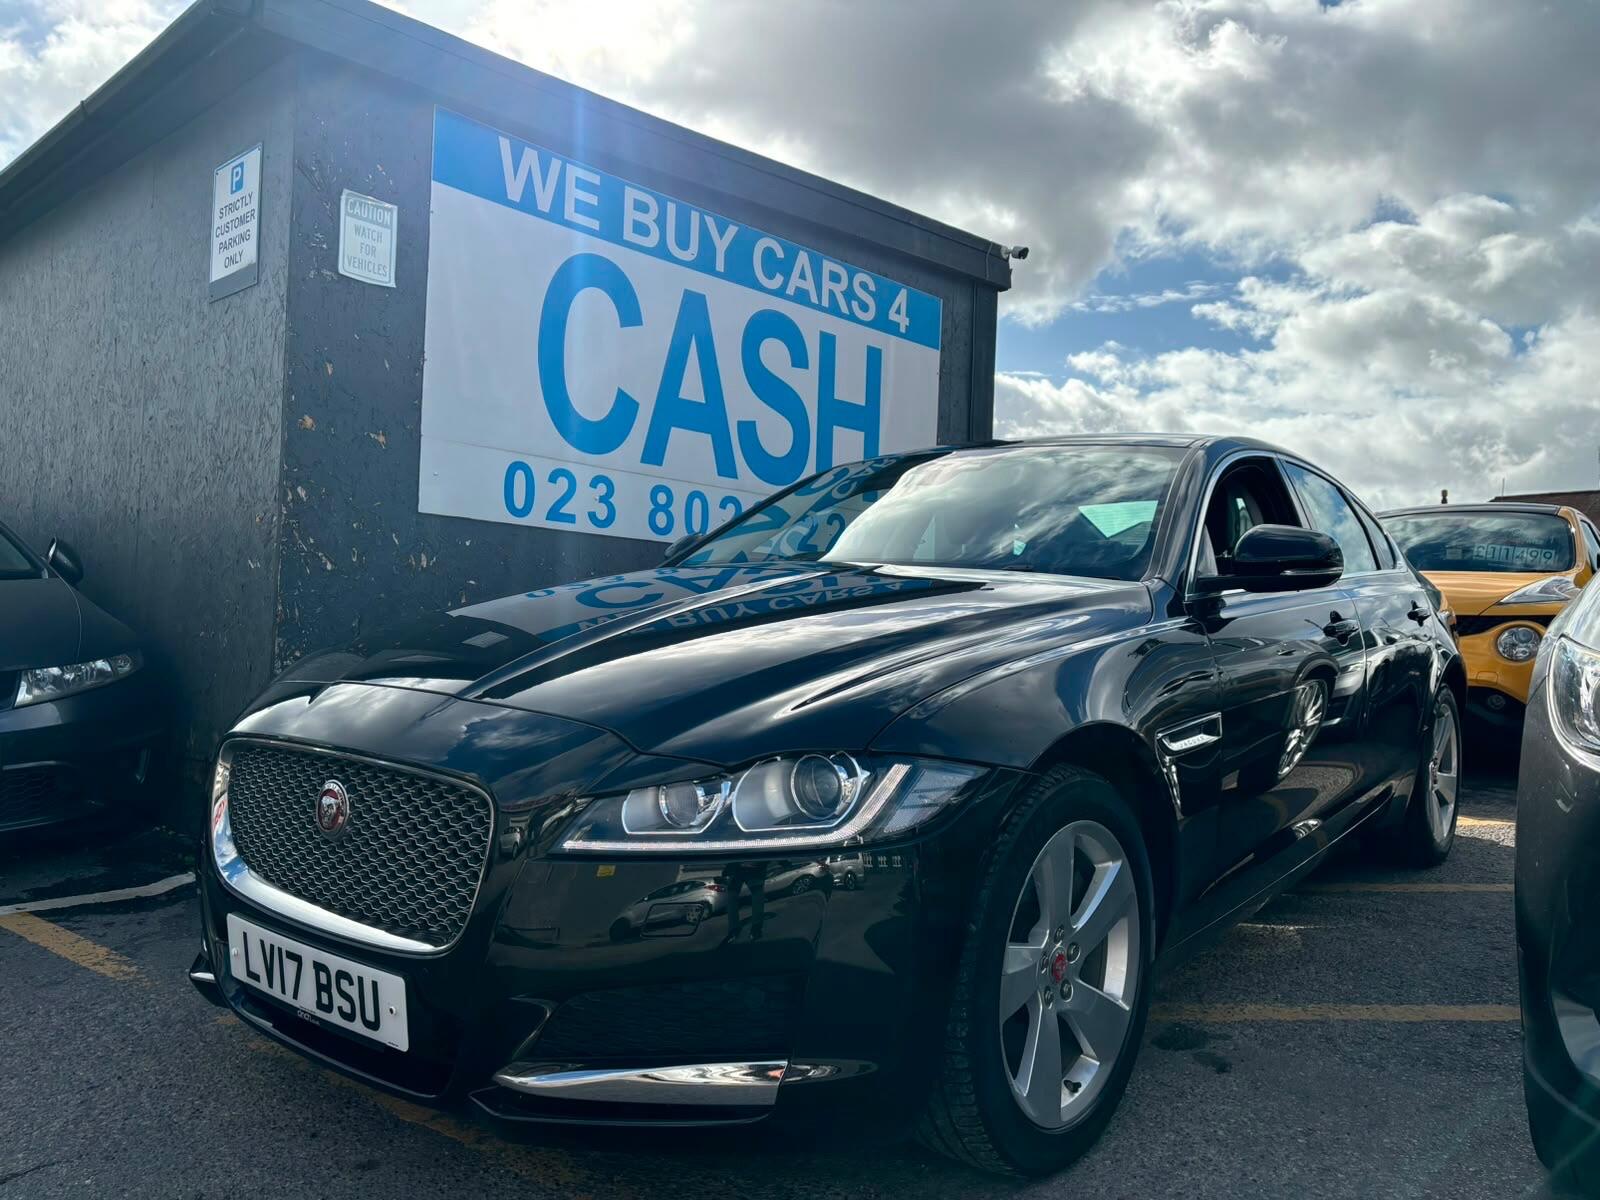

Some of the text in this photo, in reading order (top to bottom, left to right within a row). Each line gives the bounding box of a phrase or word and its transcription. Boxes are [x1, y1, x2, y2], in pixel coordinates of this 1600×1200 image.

[232, 165, 244, 192] P
[218, 191, 254, 220] STRICTLY
[347, 199, 392, 225] CAUTION
[215, 208, 256, 239] CUSTOMER
[354, 223, 383, 244] WATCH
[499, 136, 911, 334] WE BUY CARS 4
[218, 229, 251, 255] PARKING
[360, 242, 377, 259] FOR
[223, 249, 244, 269] ONLY
[347, 253, 388, 278] VEHICLES
[538, 252, 883, 488] CASH
[503, 460, 617, 529] 023
[242, 931, 381, 1032] LV17 BSU
